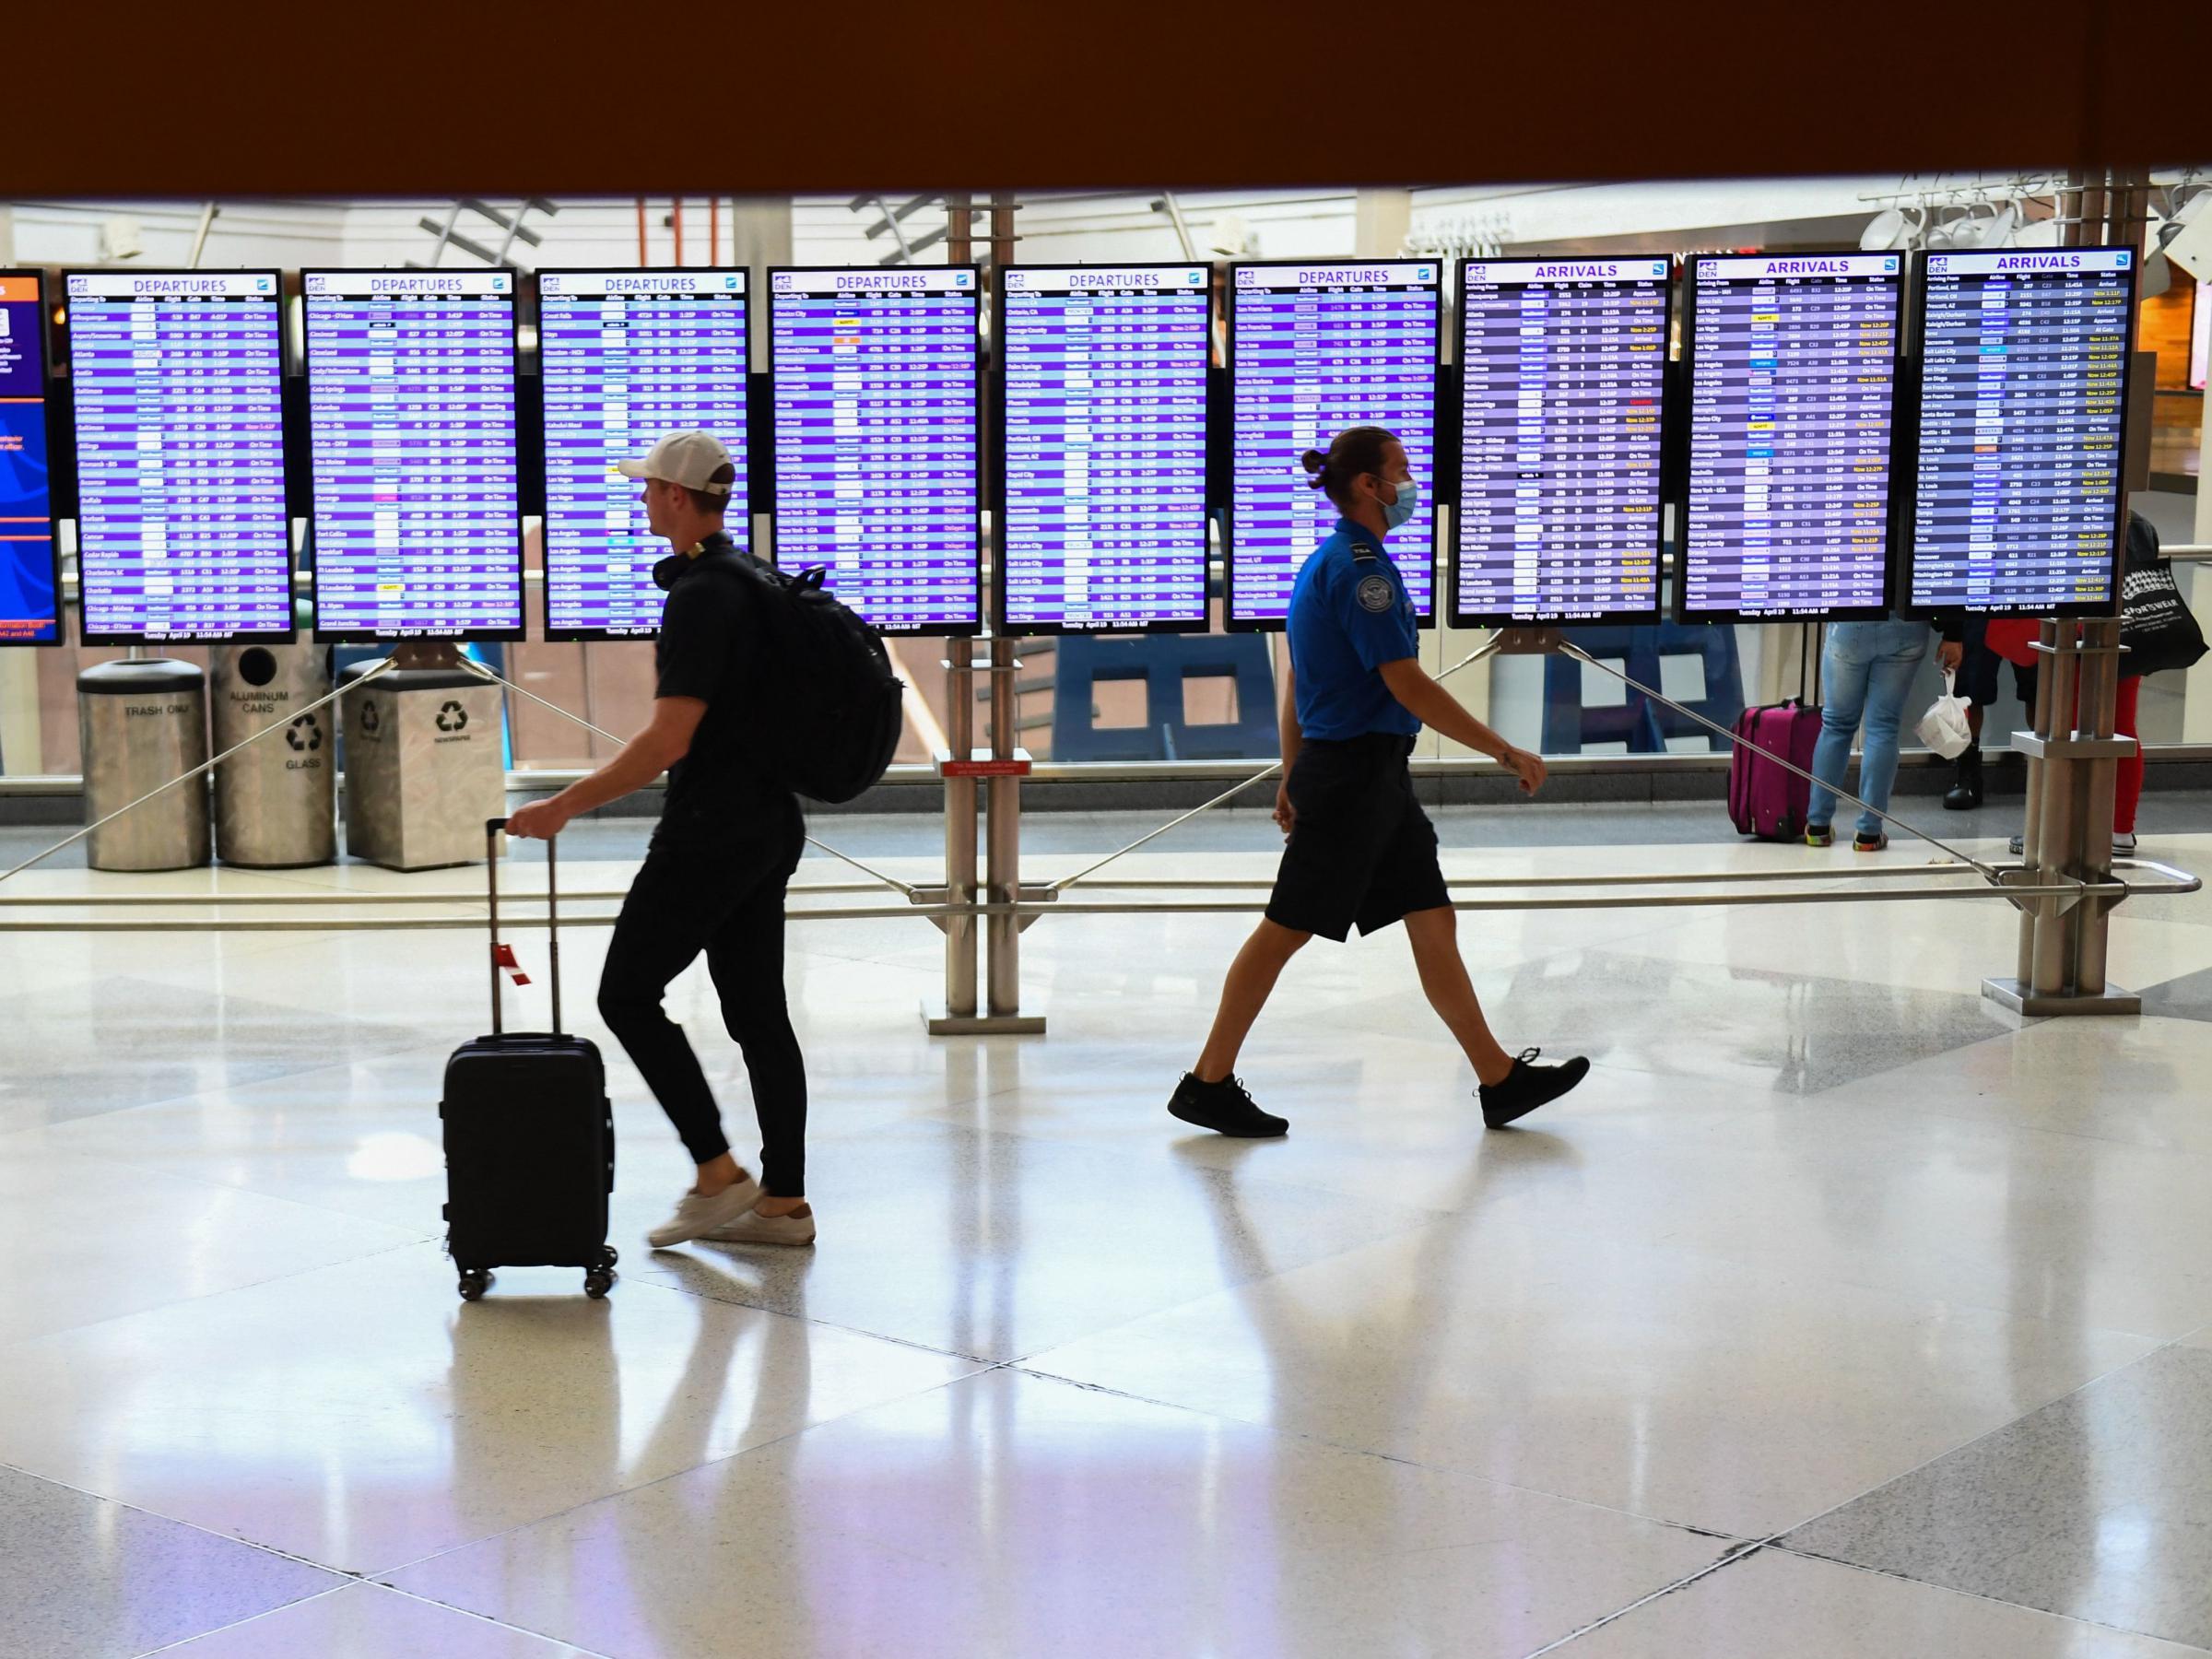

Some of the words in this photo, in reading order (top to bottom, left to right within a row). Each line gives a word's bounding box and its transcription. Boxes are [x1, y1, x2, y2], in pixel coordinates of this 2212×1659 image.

[1767, 261, 1849, 273] ARRIVALS
[1997, 255, 2079, 268] ARRIVALS
[1535, 265, 1617, 276] ARRIVALS
[837, 276, 926, 288] DEPARTURES
[1069, 274, 1159, 287] DEPARTURES
[1300, 270, 1388, 284] DEPARTURES
[135, 280, 227, 292] DEPARTURES
[371, 279, 462, 290] DEPARTURES
[606, 278, 696, 290] DEPARTURES
[230, 691, 288, 701] ALUMINUM
[125, 706, 162, 716] TRASH
[243, 703, 274, 712] CANS
[287, 759, 321, 770] GLASS
